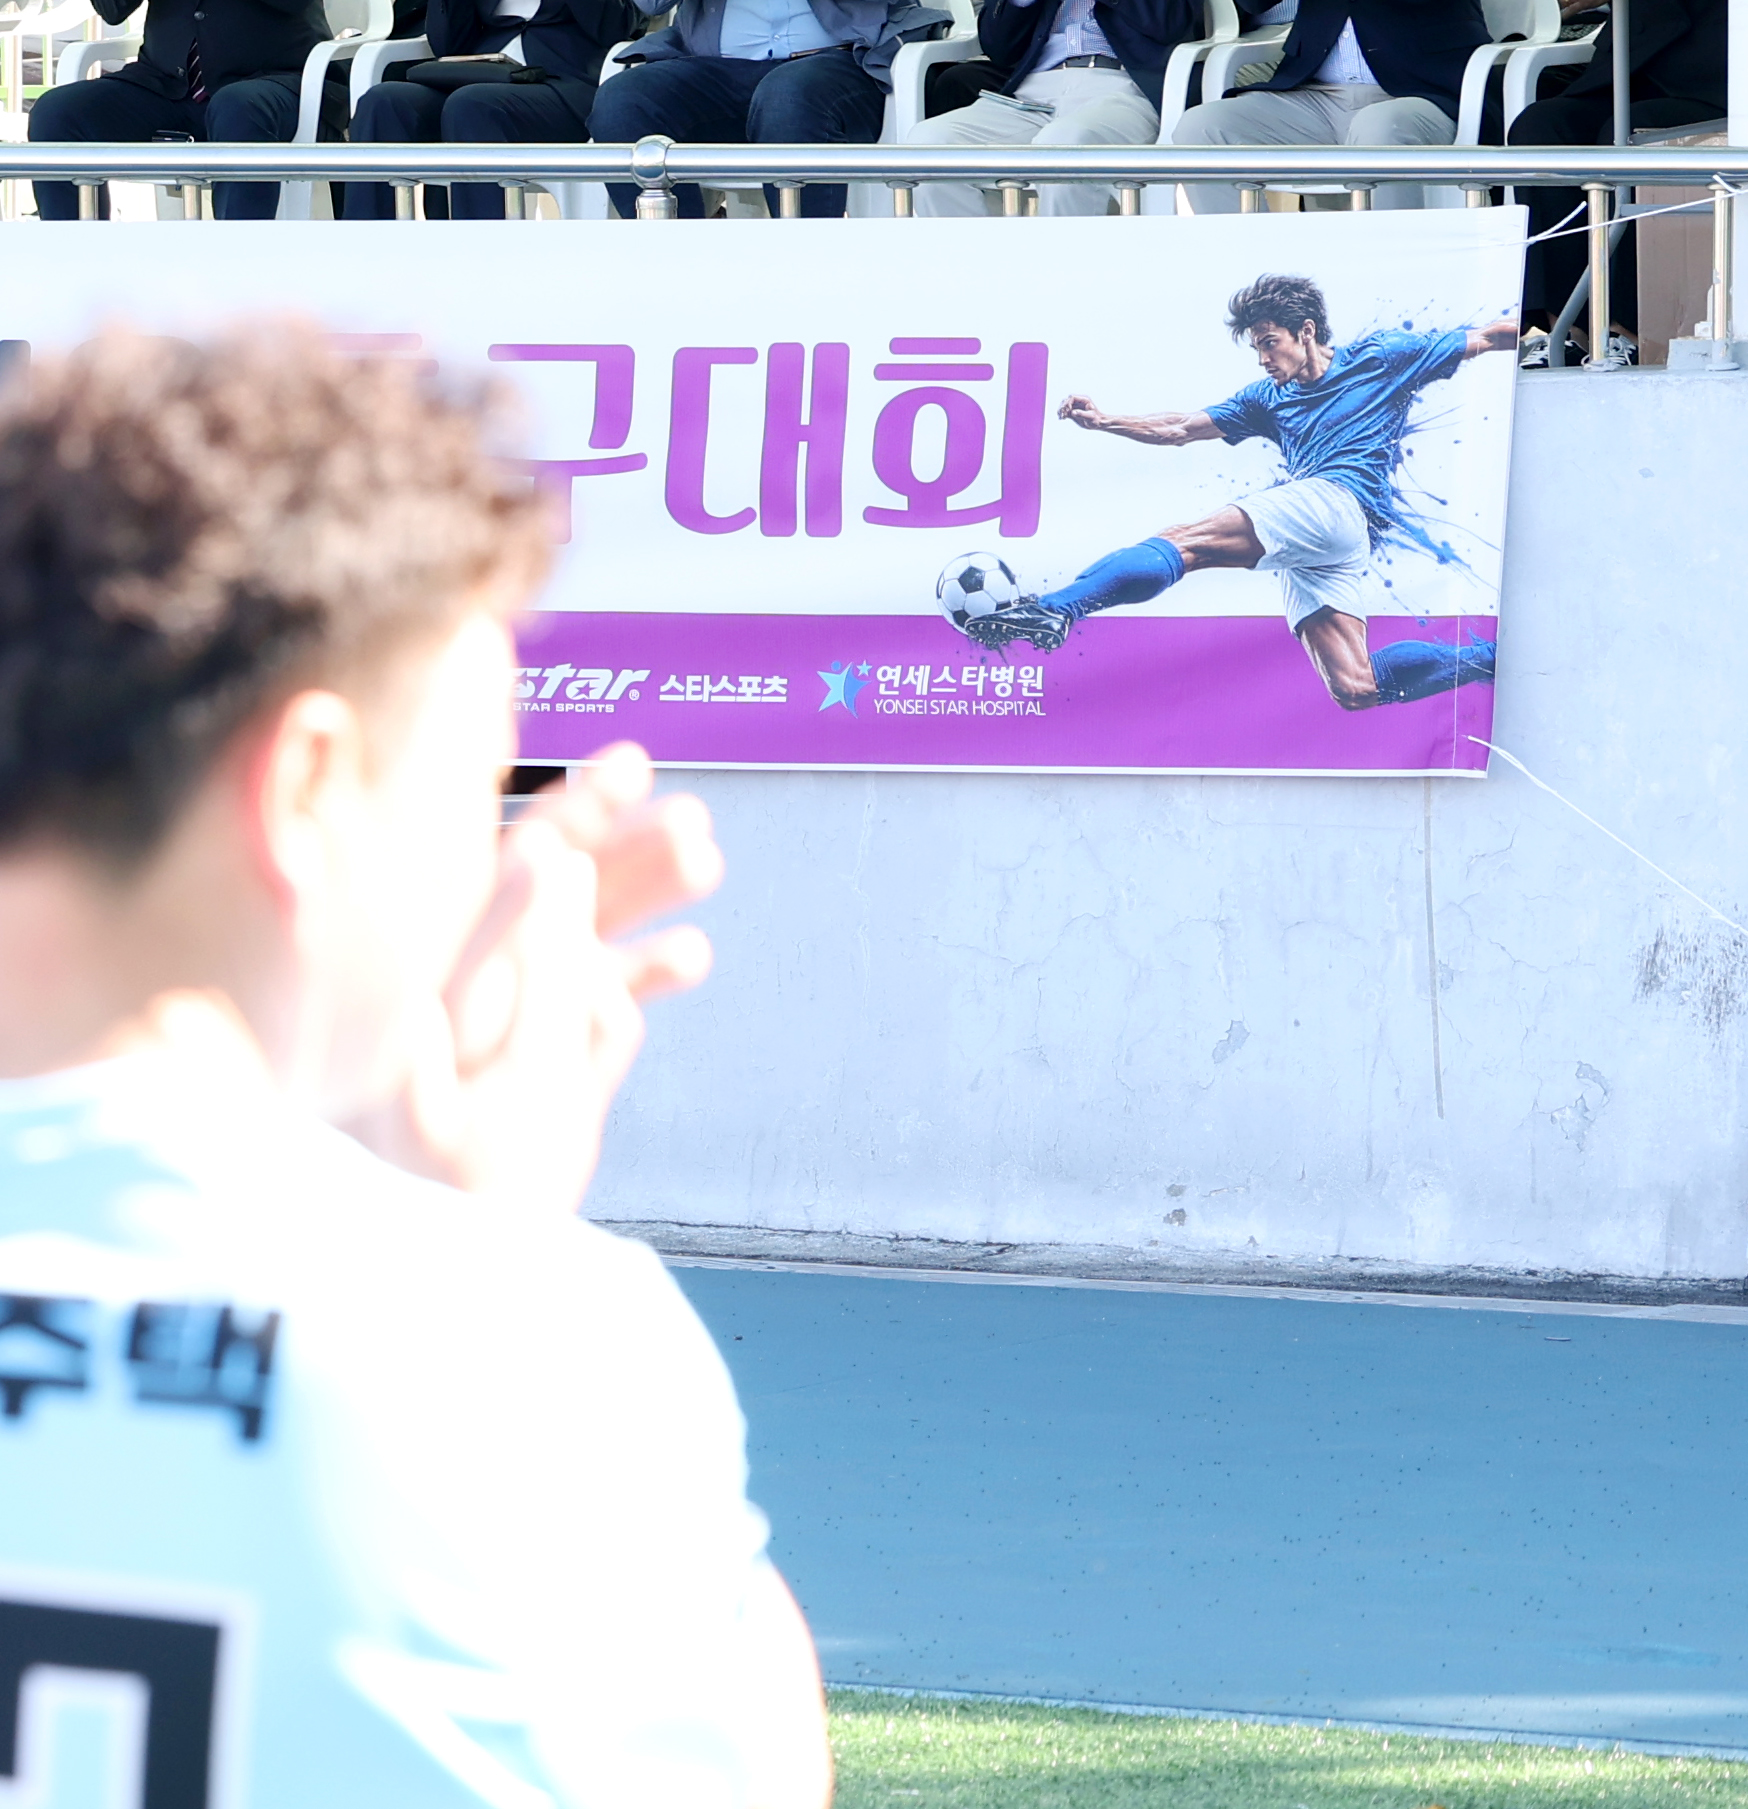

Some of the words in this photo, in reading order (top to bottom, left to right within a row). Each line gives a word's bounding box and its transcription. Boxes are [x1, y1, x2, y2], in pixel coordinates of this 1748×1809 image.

[334, 333, 1050, 543] 구대회
[658, 674, 789, 703] 스타스포츠
[876, 664, 1045, 698] 연세스타병원
[555, 703, 615, 713] SPORTS
[873, 698, 928, 715] YONSEI
[930, 700, 969, 716] STAR
[972, 700, 1047, 717] HOSPITAL
